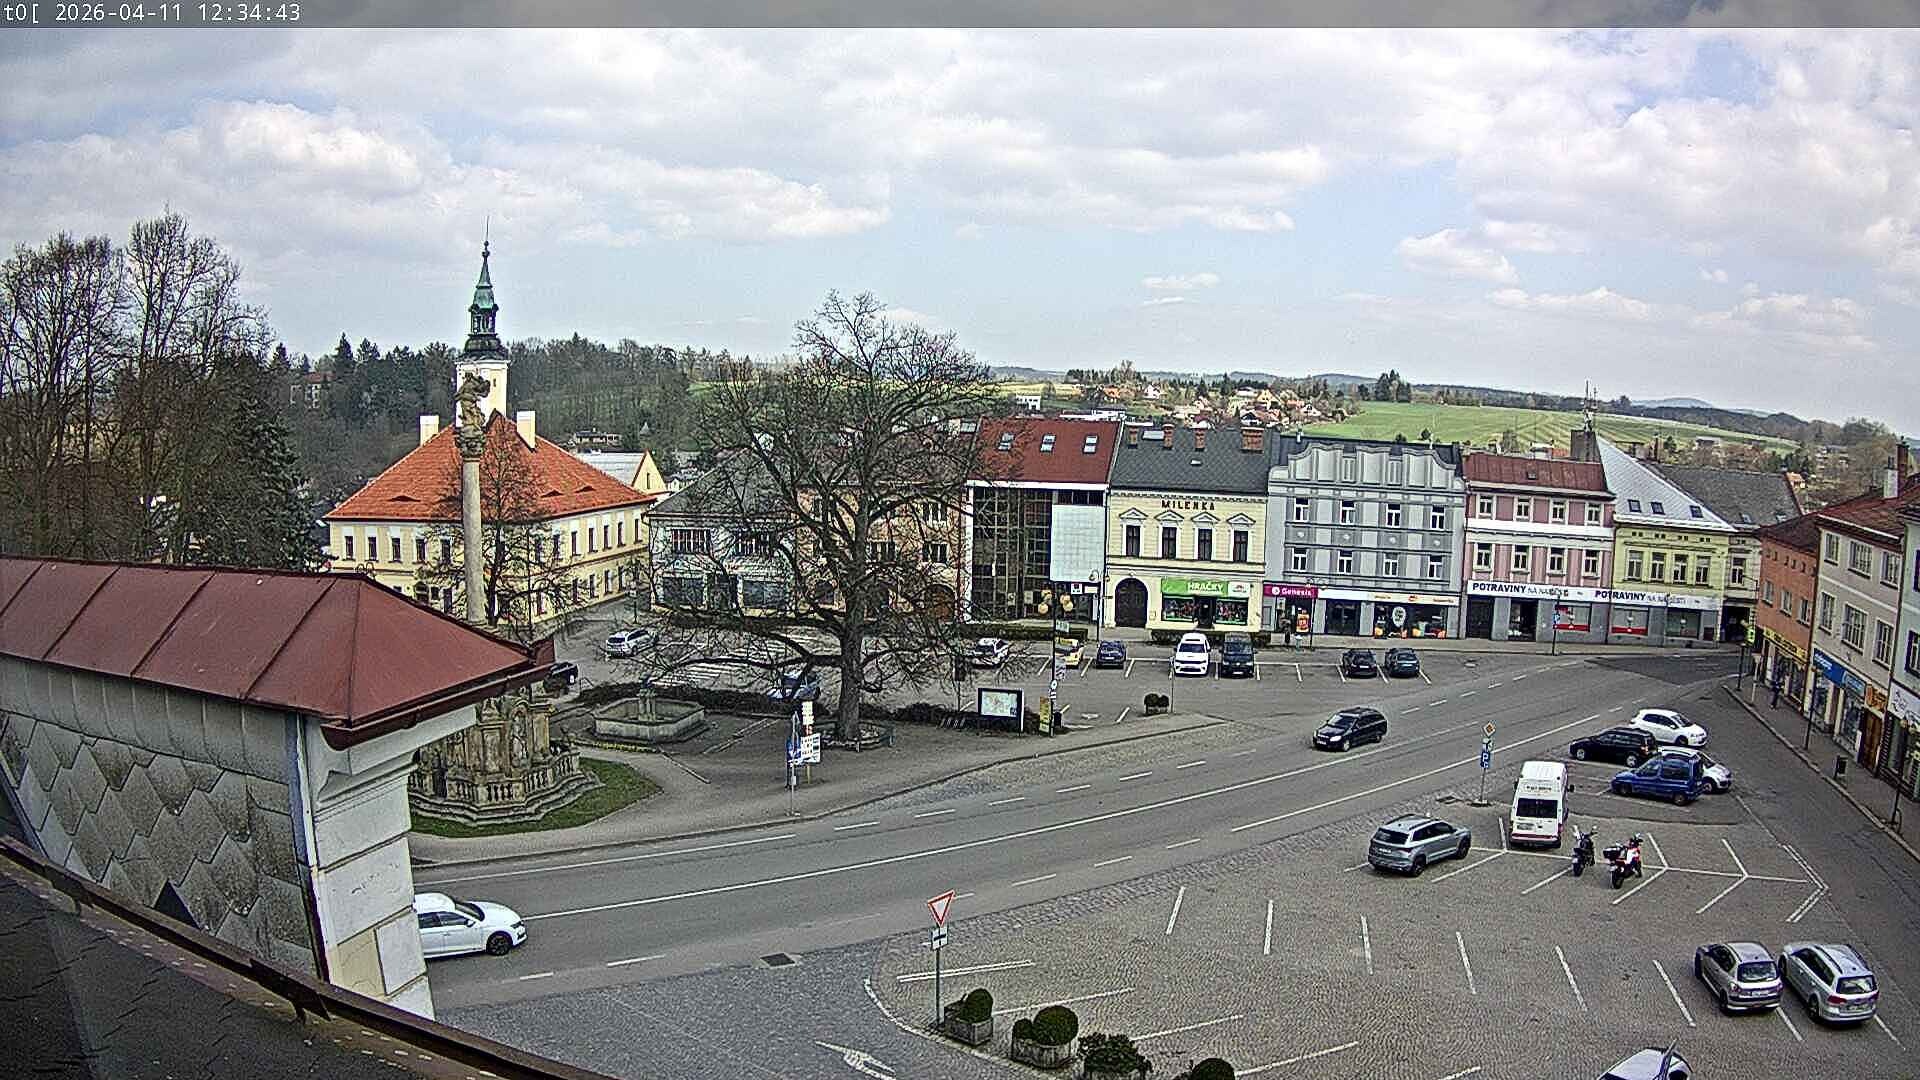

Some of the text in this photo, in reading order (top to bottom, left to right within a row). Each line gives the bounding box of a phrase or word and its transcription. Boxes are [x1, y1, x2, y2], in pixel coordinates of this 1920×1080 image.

[1161, 500, 1215, 511] MILENKA
[1187, 581, 1224, 592] HRAČKY
[1281, 587, 1312, 596] Genesis
[1472, 582, 1527, 594] POTRAVINY
[1594, 590, 1646, 601] POTRAVINY
